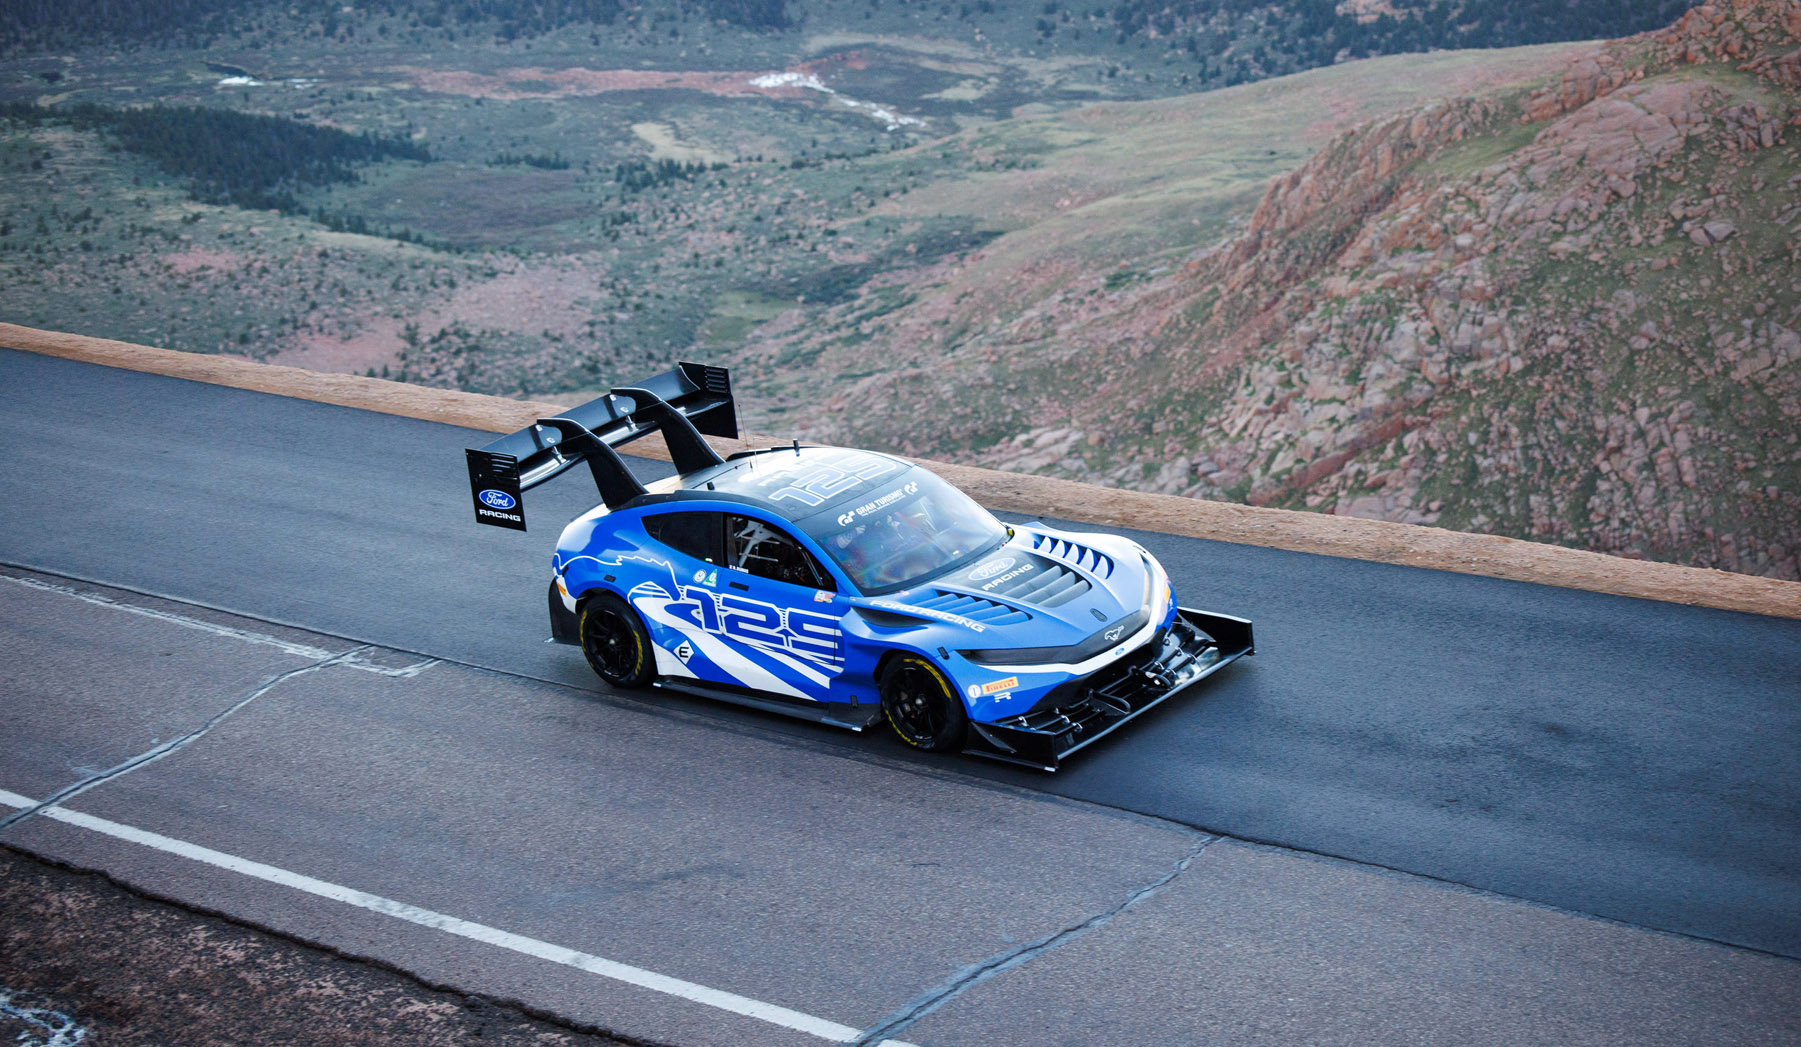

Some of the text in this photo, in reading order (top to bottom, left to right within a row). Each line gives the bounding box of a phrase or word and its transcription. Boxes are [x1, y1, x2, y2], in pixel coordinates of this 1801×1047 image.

[768, 456, 897, 507] 125
[484, 491, 510, 507] Ford
[855, 502, 876, 515] GRAN
[479, 509, 521, 521] RACING
[974, 559, 1011, 578] Ford
[981, 563, 1034, 591] RACING
[684, 585, 846, 663] 125
[870, 599, 986, 633] FORD RACING
[679, 646, 690, 658] E
